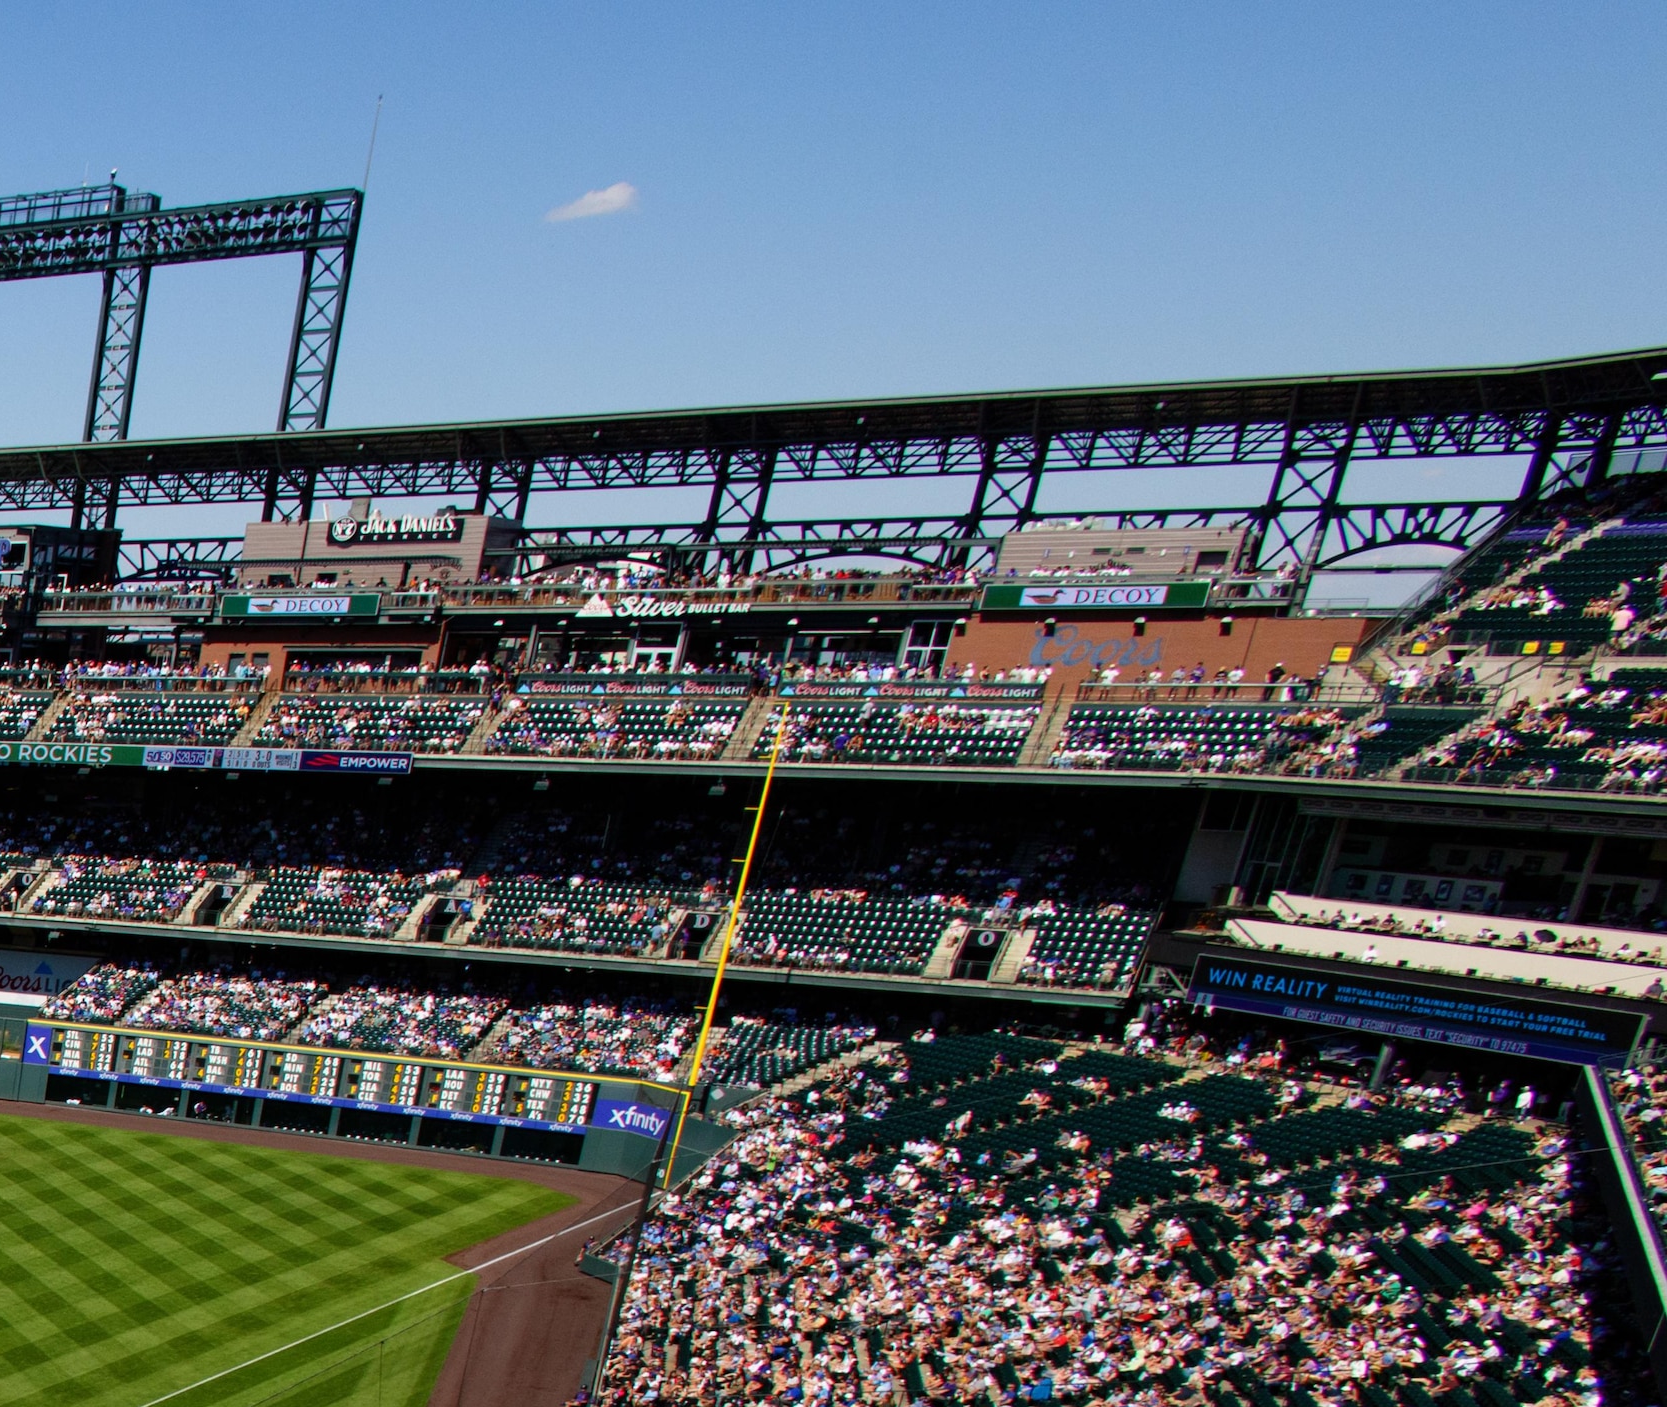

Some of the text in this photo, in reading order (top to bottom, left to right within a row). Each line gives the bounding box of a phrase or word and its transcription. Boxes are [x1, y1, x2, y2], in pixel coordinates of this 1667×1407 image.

[361, 519, 396, 534] JACK
[361, 533, 452, 541] TERRACE
[1074, 588, 1160, 604] DECOY
[286, 600, 345, 611] DECOY
[618, 596, 750, 617] Silver BULLET BAR
[1030, 625, 1163, 667] Coors
[531, 681, 591, 693] Coors LIGHT
[683, 681, 746, 694] Coors LIGHT
[795, 684, 861, 696] Coors LIGHT
[967, 685, 1038, 697] Coors LIGHT
[19, 744, 112, 763] ROCKIES
[339, 757, 407, 769] EMPOWER
[1209, 968, 1328, 998] WIN REALITY
[1337, 986, 1585, 1028] VIRTUAL REALITY TRAINING FOR BASEBALL SOFTBALL
[364, 1062, 382, 1071] MIL
[530, 1089, 550, 1099] CHW
[609, 1106, 665, 1136] xfinity
